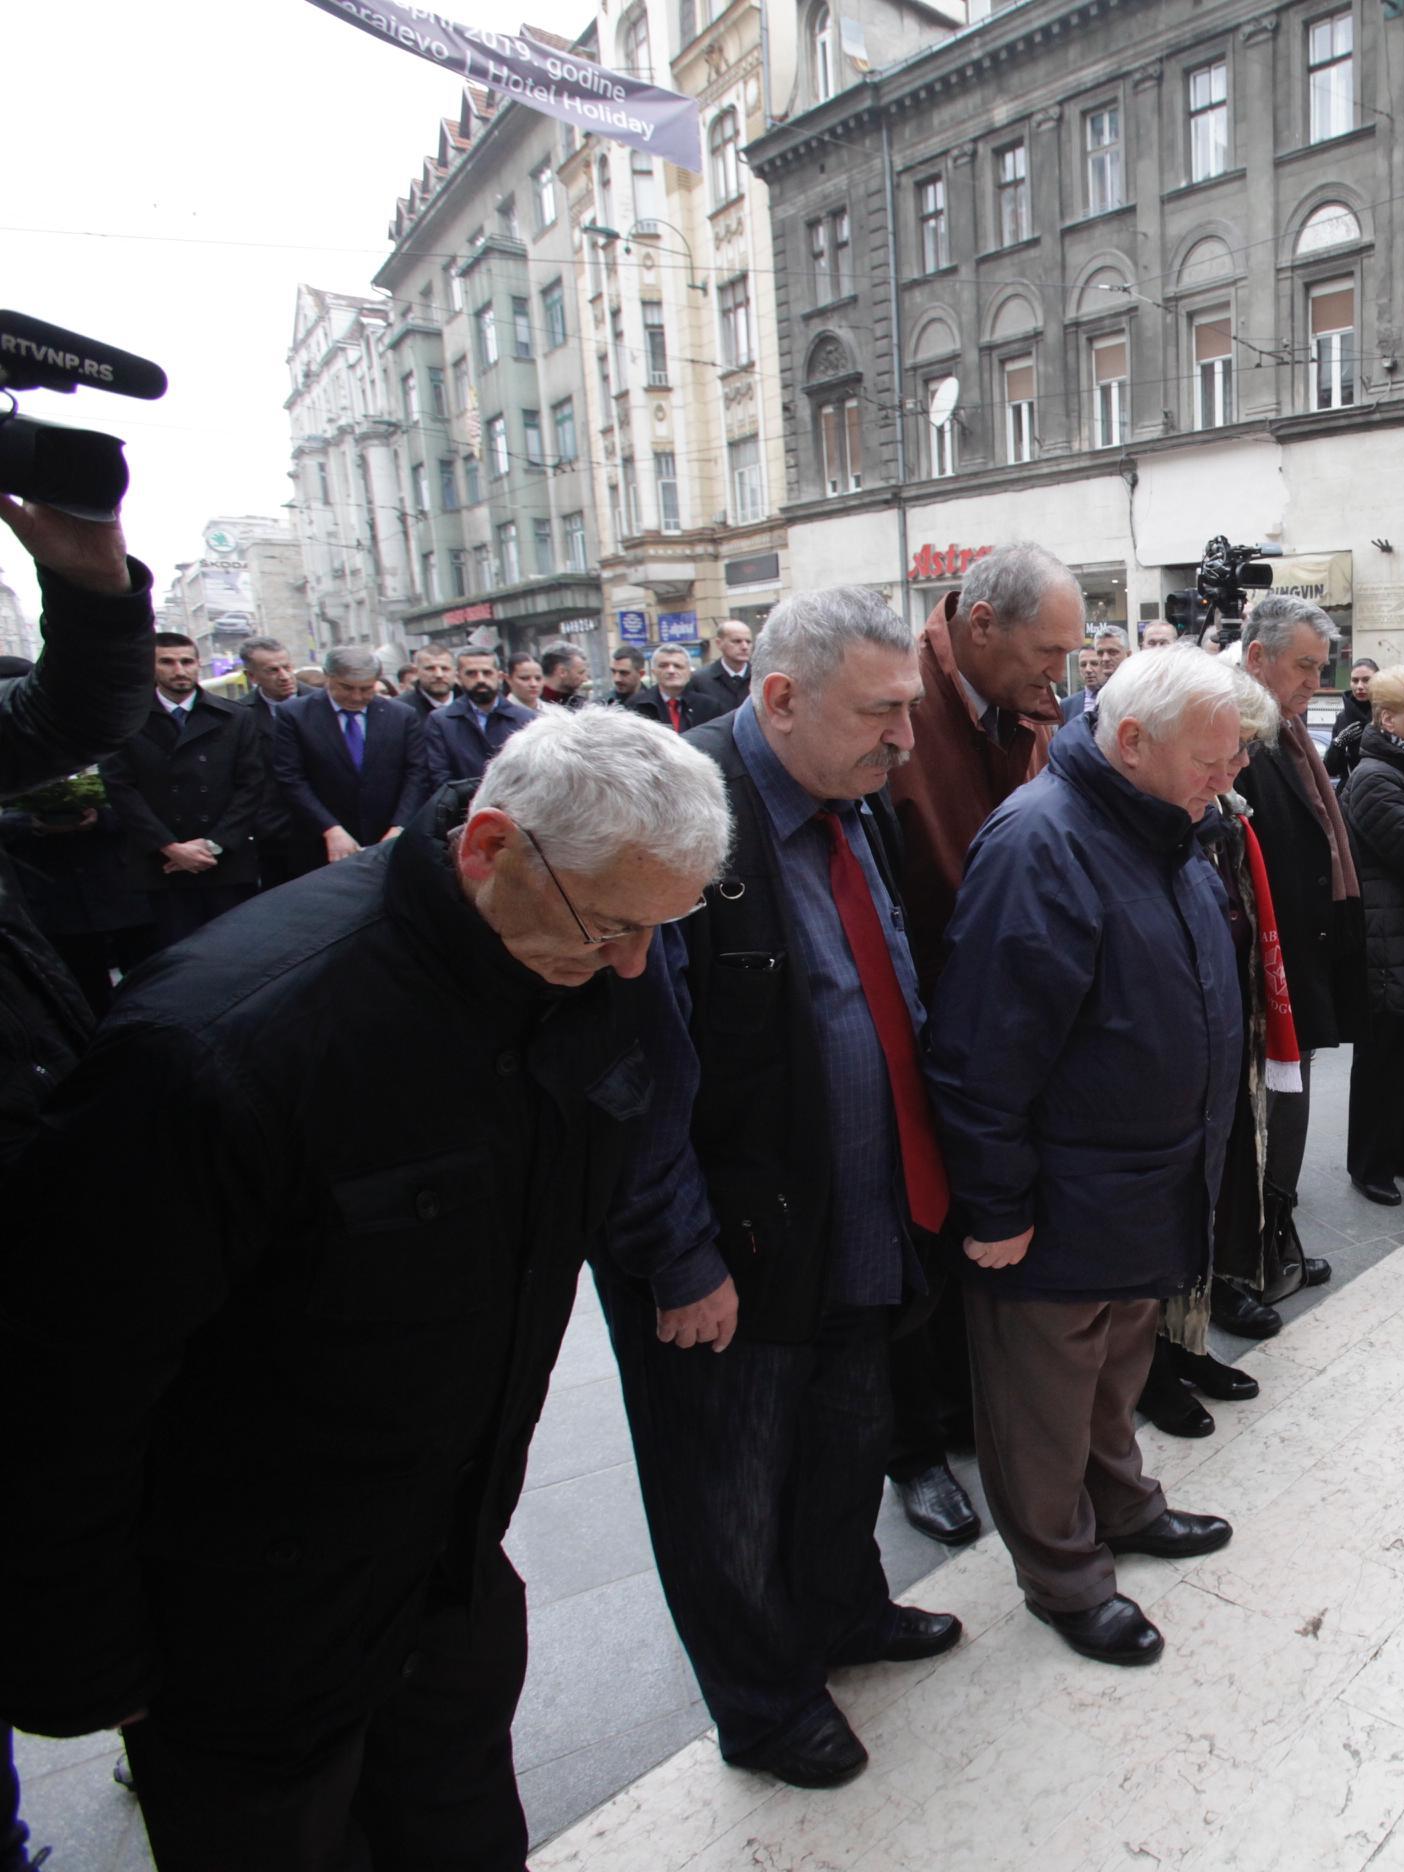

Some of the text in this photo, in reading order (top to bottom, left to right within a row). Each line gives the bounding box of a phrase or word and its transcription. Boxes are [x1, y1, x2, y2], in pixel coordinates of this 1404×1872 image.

[488, 60, 556, 105] Hotel
[562, 91, 655, 142] Holiday
[546, 57, 626, 103] godine
[1, 333, 114, 382] RTVNP.RS
